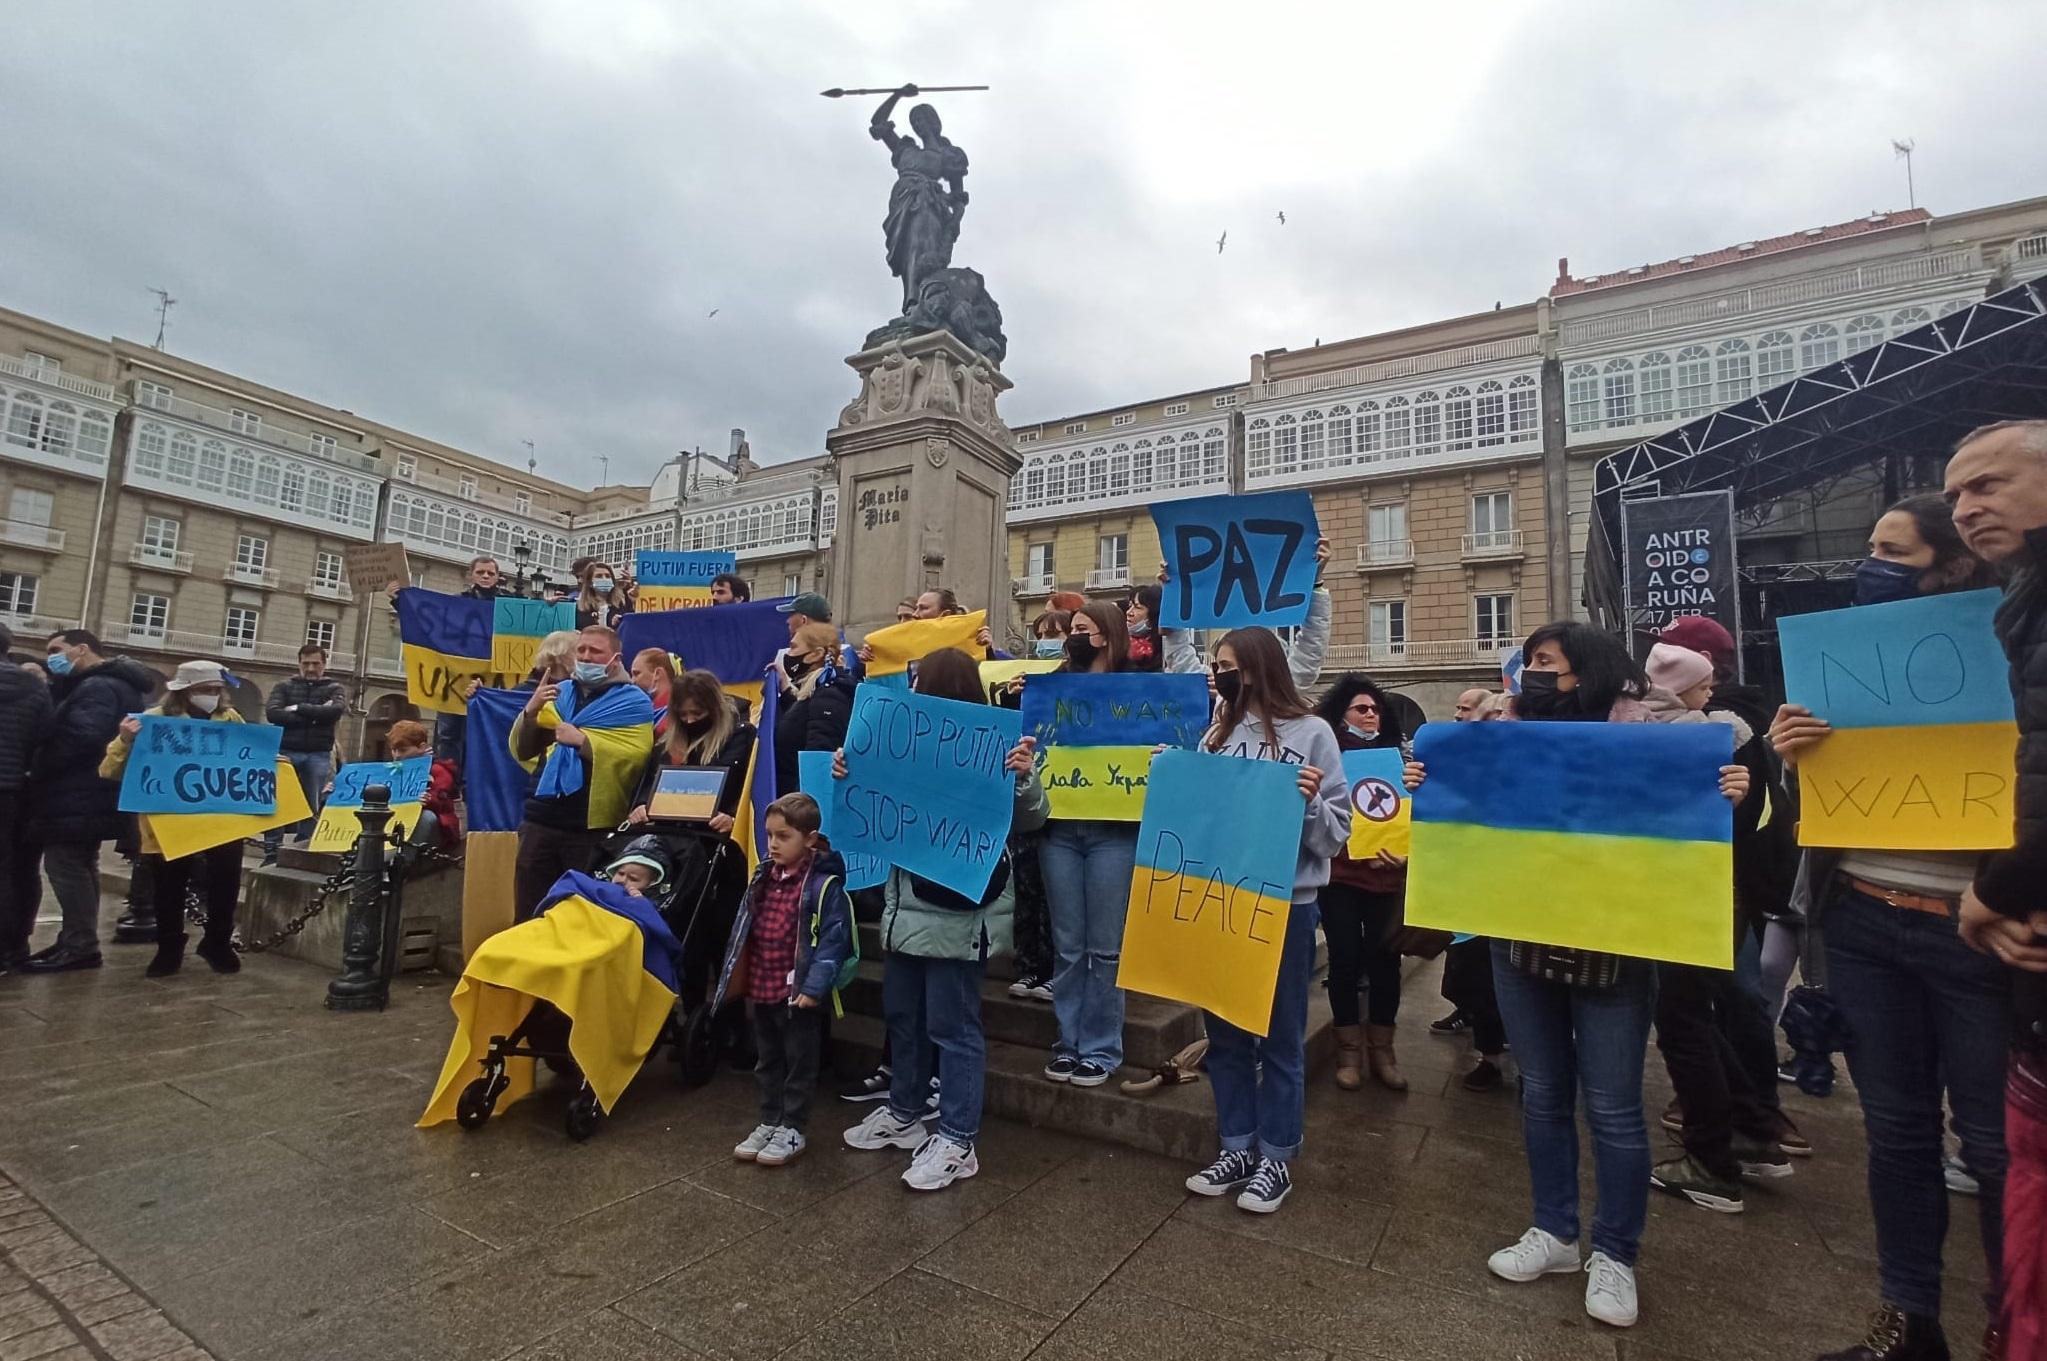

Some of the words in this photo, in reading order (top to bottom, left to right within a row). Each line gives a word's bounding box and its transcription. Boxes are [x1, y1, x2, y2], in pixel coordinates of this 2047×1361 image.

[865, 508, 900, 530] Pita
[1645, 529, 1711, 550] ANTR
[1175, 519, 1306, 621] PAZ
[1648, 571, 1665, 587] A
[1671, 567, 1710, 585] CO
[640, 596, 657, 613] DE
[1648, 585, 1716, 607] RUÑA
[1649, 610, 1665, 624] 17
[1821, 633, 1966, 709] NO
[851, 696, 932, 762] STOP
[1055, 697, 1093, 728] NO
[1110, 697, 1182, 722] WAR
[152, 723, 227, 755] NO
[239, 746, 256, 760] a
[141, 765, 165, 795] la
[174, 763, 277, 805] GUERRA
[1807, 771, 2007, 819] WAR
[845, 784, 919, 845] STOP
[1146, 830, 1285, 945] PEACE
